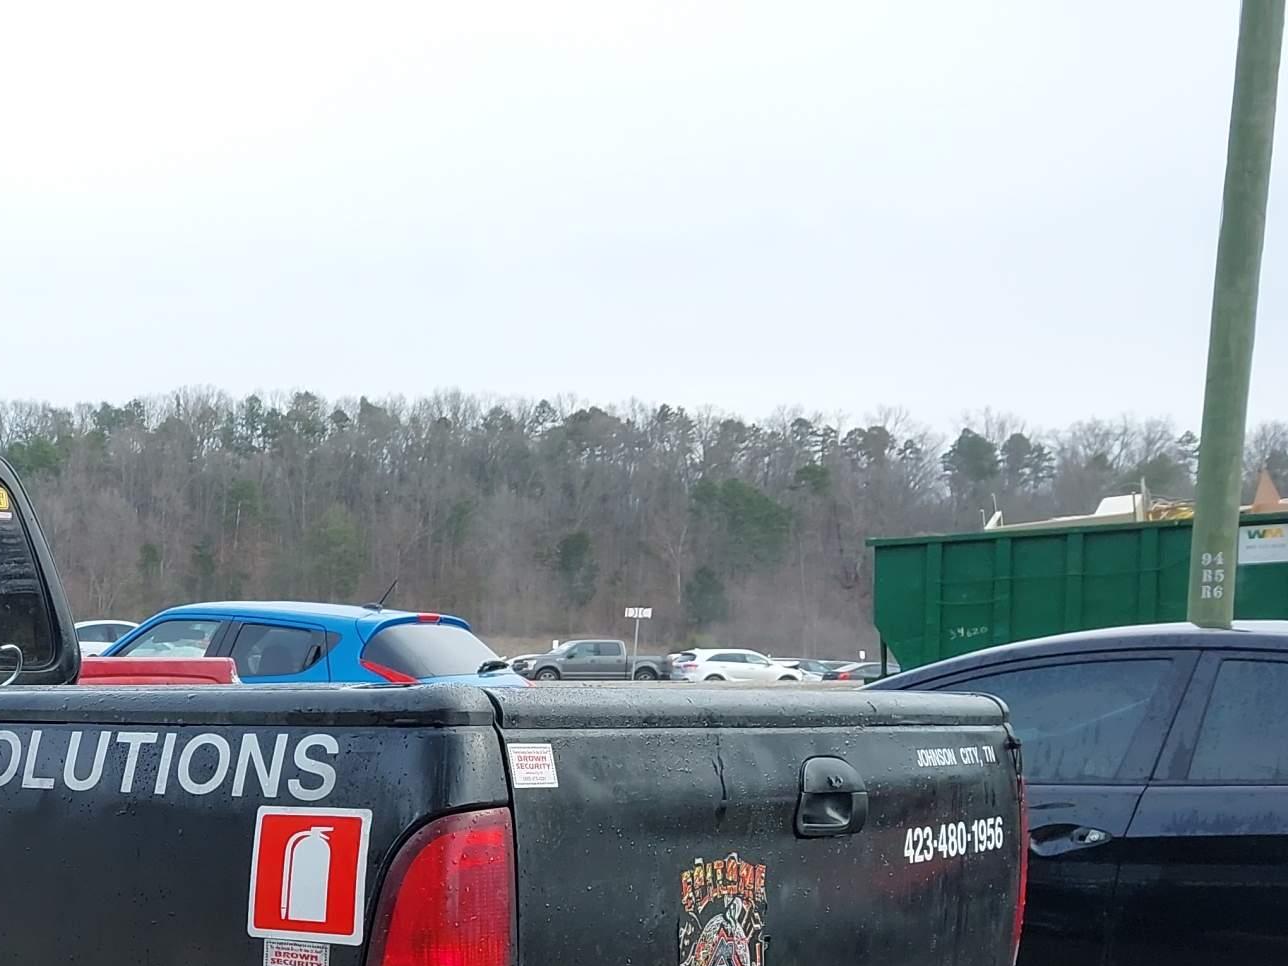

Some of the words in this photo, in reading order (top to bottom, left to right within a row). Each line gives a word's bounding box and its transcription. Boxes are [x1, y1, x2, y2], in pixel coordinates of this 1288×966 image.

[1201, 552, 1224, 566] 94
[1200, 585, 1223, 599] R6
[916, 747, 957, 767] JOHNSON
[959, 746, 983, 767] CITY,
[982, 745, 996, 762] TN
[516, 763, 551, 771] SECURITY
[903, 816, 1004, 864] 423-480-1956
[274, 951, 319, 962] BROWN
